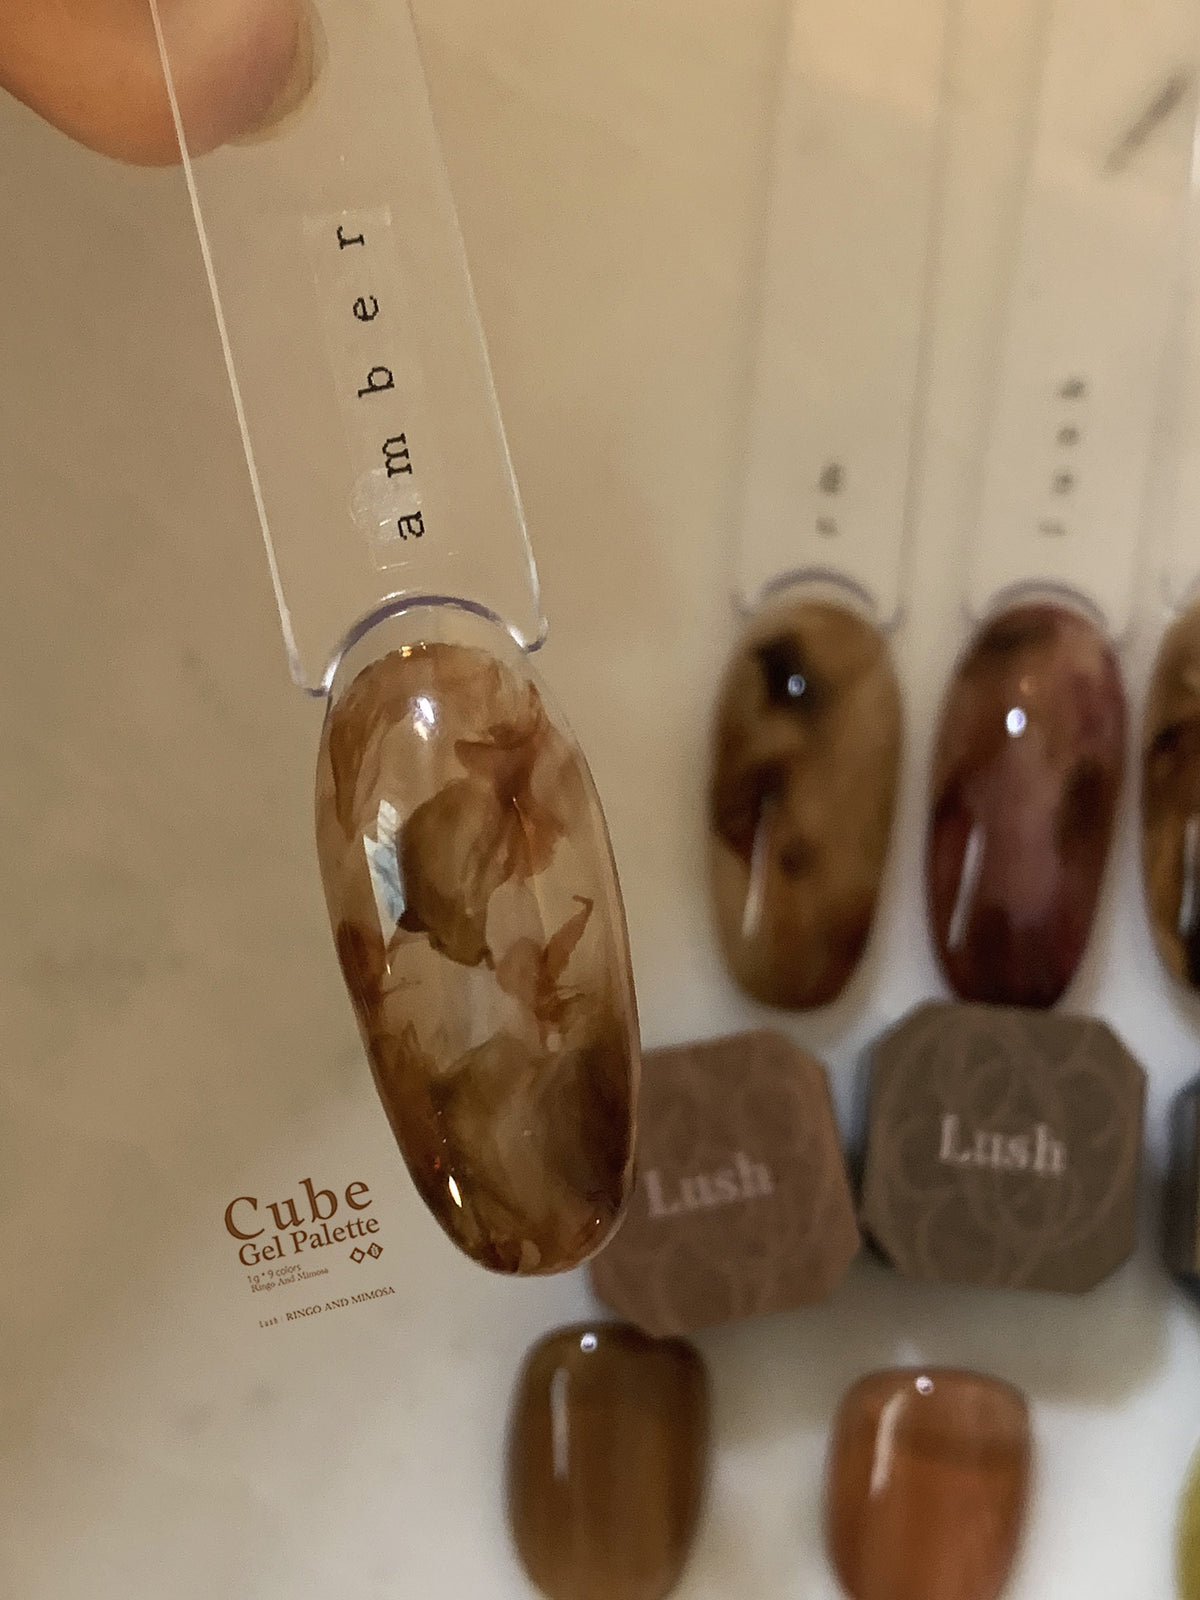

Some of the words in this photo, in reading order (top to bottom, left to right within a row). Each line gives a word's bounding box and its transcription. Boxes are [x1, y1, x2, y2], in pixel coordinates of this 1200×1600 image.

[332, 226, 425, 540] amber
[939, 1114, 1067, 1177] Lush
[224, 1177, 373, 1240] Cube
[644, 1149, 775, 1220] Lush
[238, 1235, 286, 1266] Gel
[289, 1217, 380, 1255] Palette
[250, 1282, 276, 1294] Ringo
[278, 1275, 296, 1287] And
[297, 1267, 329, 1282] Mimosa
[275, 1264, 302, 1277] colors
[286, 1305, 322, 1322] RINGO
[324, 1298, 349, 1312] AND
[351, 1286, 396, 1305] MIMOSA
